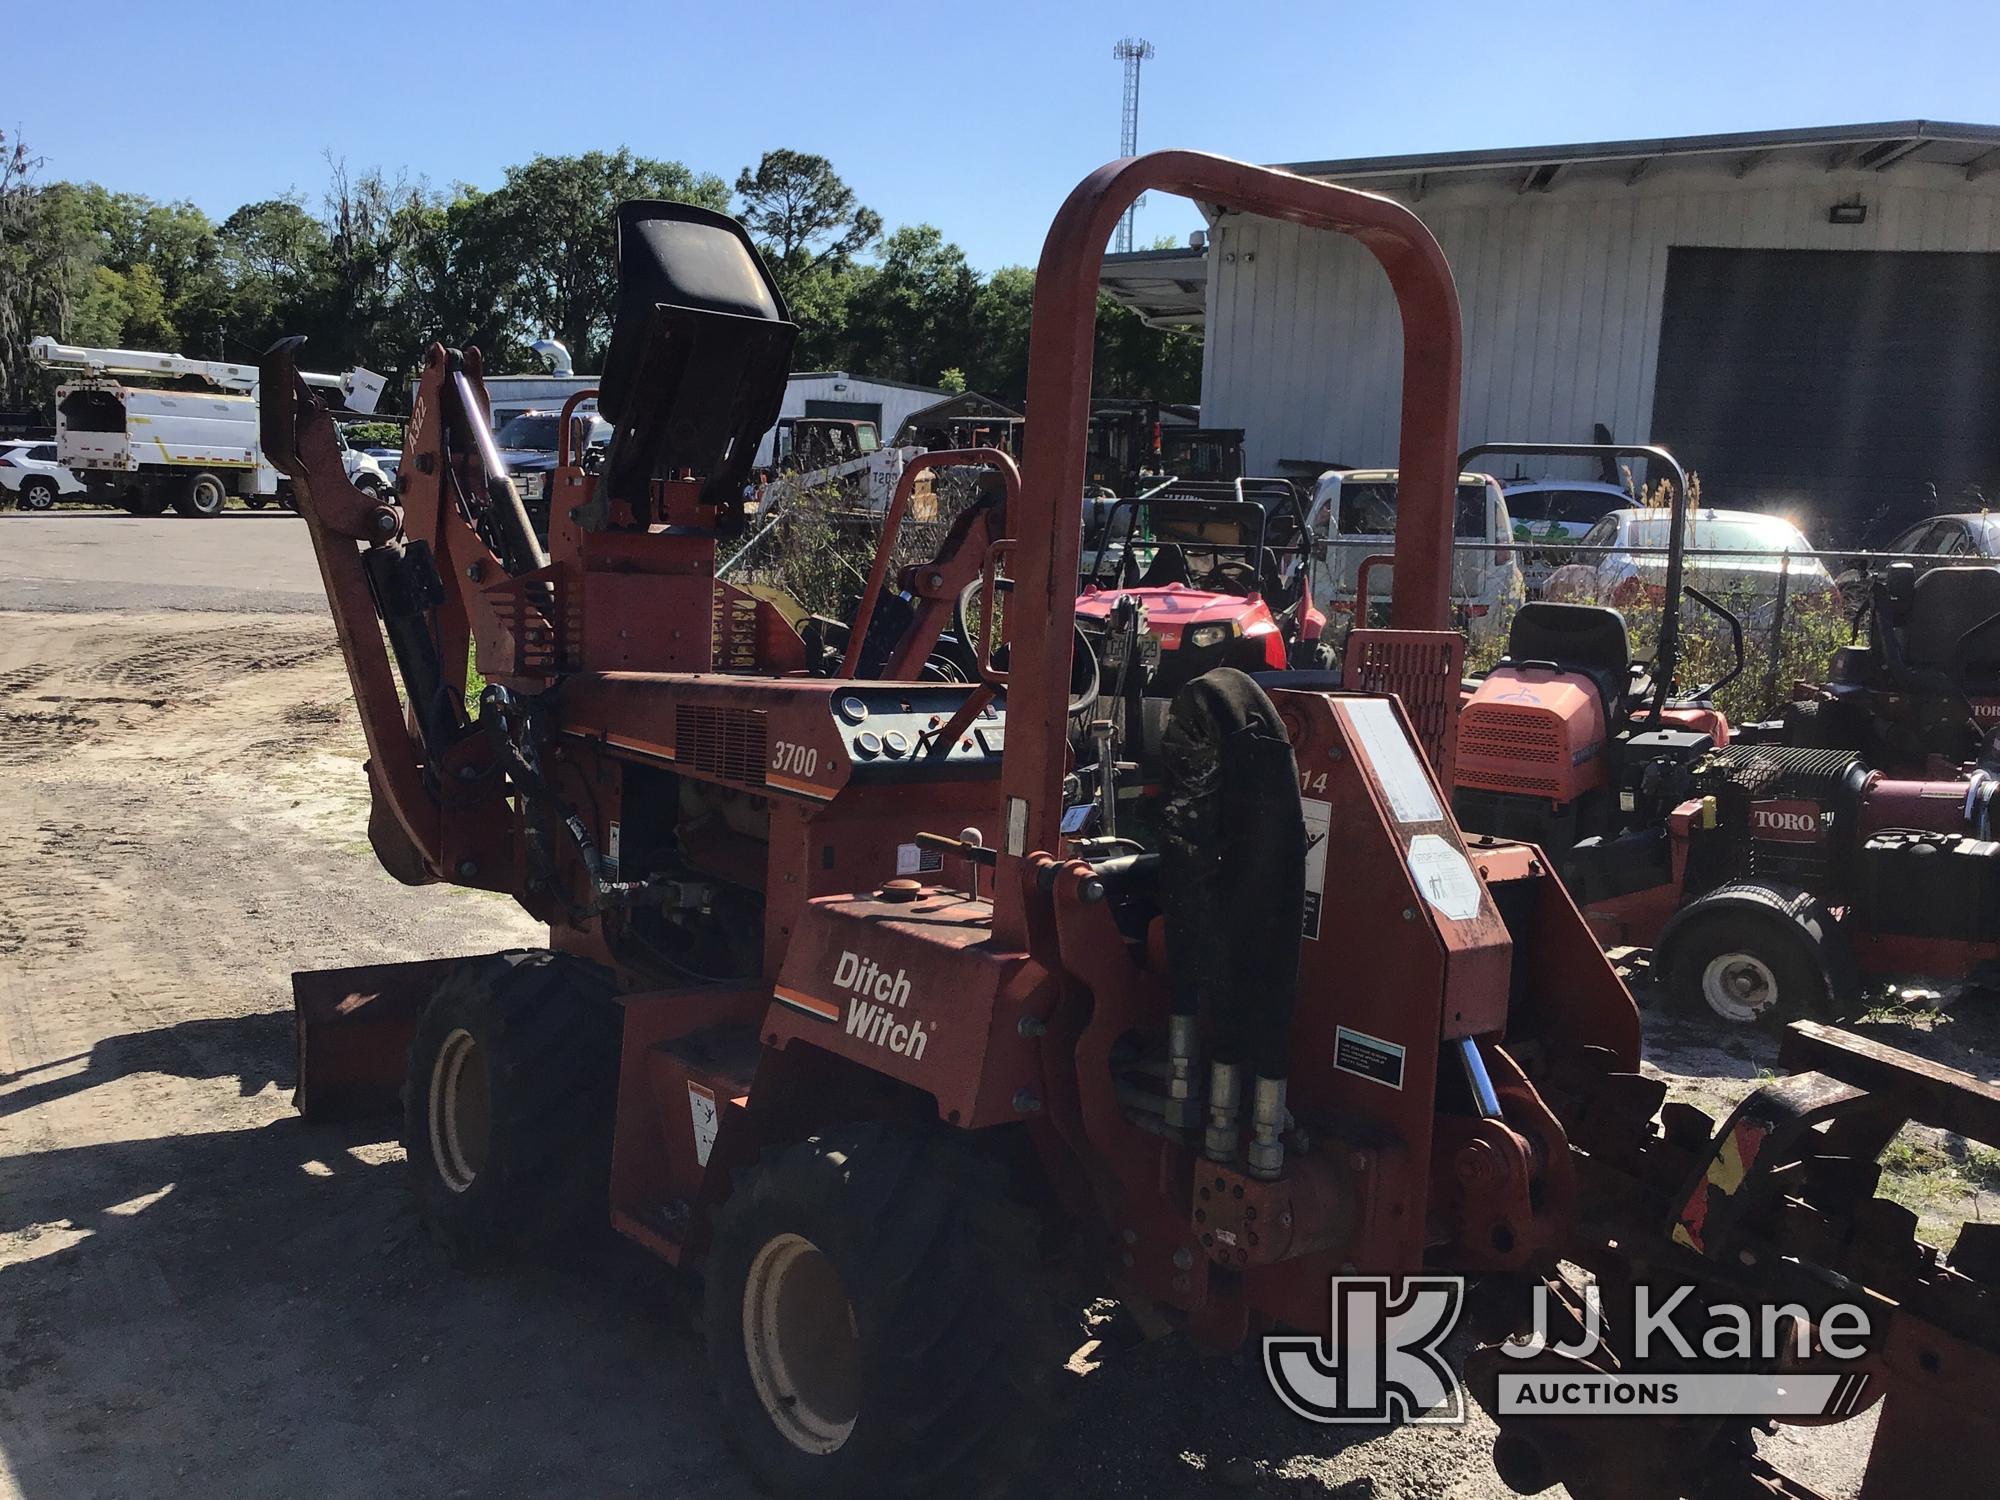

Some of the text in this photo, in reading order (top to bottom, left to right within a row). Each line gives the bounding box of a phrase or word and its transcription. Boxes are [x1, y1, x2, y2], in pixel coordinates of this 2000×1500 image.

[408, 396, 427, 455] A322
[772, 741, 818, 777] 3700
[1301, 769, 1329, 793] 14
[1754, 811, 1816, 832] TORO
[833, 950, 912, 1008] Ditch
[845, 997, 928, 1061] Witch
